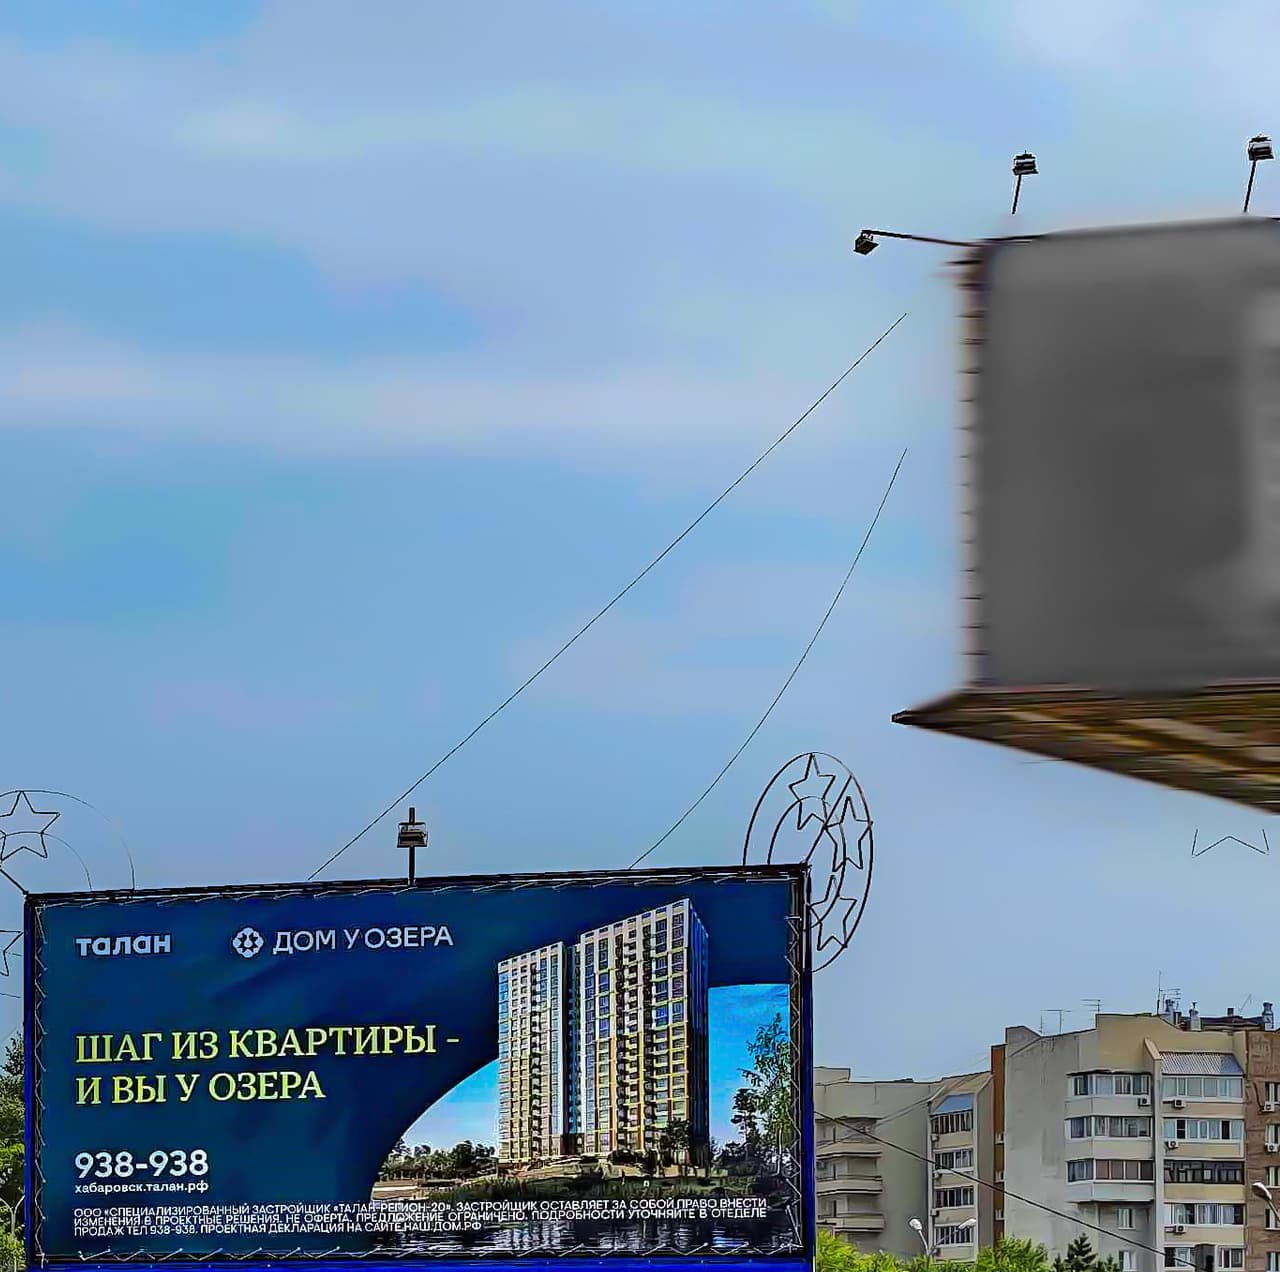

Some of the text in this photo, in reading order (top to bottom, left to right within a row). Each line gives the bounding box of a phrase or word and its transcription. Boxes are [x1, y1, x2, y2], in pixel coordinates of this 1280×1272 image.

[75, 934, 172, 958] талан
[272, 925, 455, 954] ДОМ У ОЗЕРА
[75, 1032, 163, 1064] ШАГ
[171, 1030, 220, 1061] ИЗ
[228, 1024, 437, 1059] КВАРТИРЫ
[75, 1071, 327, 1105] И ВЫ У ОЗЕРА
[74, 1149, 209, 1179] 938-938
[74, 1180, 209, 1196] хабаровск.талан.рф
[73, 1207, 102, 1218] ООО
[252, 1202, 331, 1215] ЗАСТРОЙЩИК
[456, 1200, 537, 1211] ЗАСТРОЙЩИК
[539, 1199, 610, 1211] ОСТАВЛЯЕТ
[612, 1199, 627, 1210] ЗА
[629, 1197, 674, 1209] СОБОЙ
[676, 1198, 717, 1209] ПРАВО
[719, 1197, 767, 1208] ВНЕСТИ
[74, 1216, 141, 1227] ИЗМЕНЕНИЯ
[155, 1214, 223, 1226] ПРОЕКТНЫЕ
[286, 1213, 301, 1224] НЕ
[356, 1212, 445, 1223] ПРЕДЛОЖЕНИЕ
[531, 1209, 625, 1221] ПОДРОБНОСТИ
[74, 1226, 125, 1237] ПРОДАЖ
[200, 1223, 267, 1235] ПРОЕКТНАЯ
[268, 1223, 345, 1234] ДЕКЛАРАЦИЯ
[346, 1222, 363, 1233] НА
